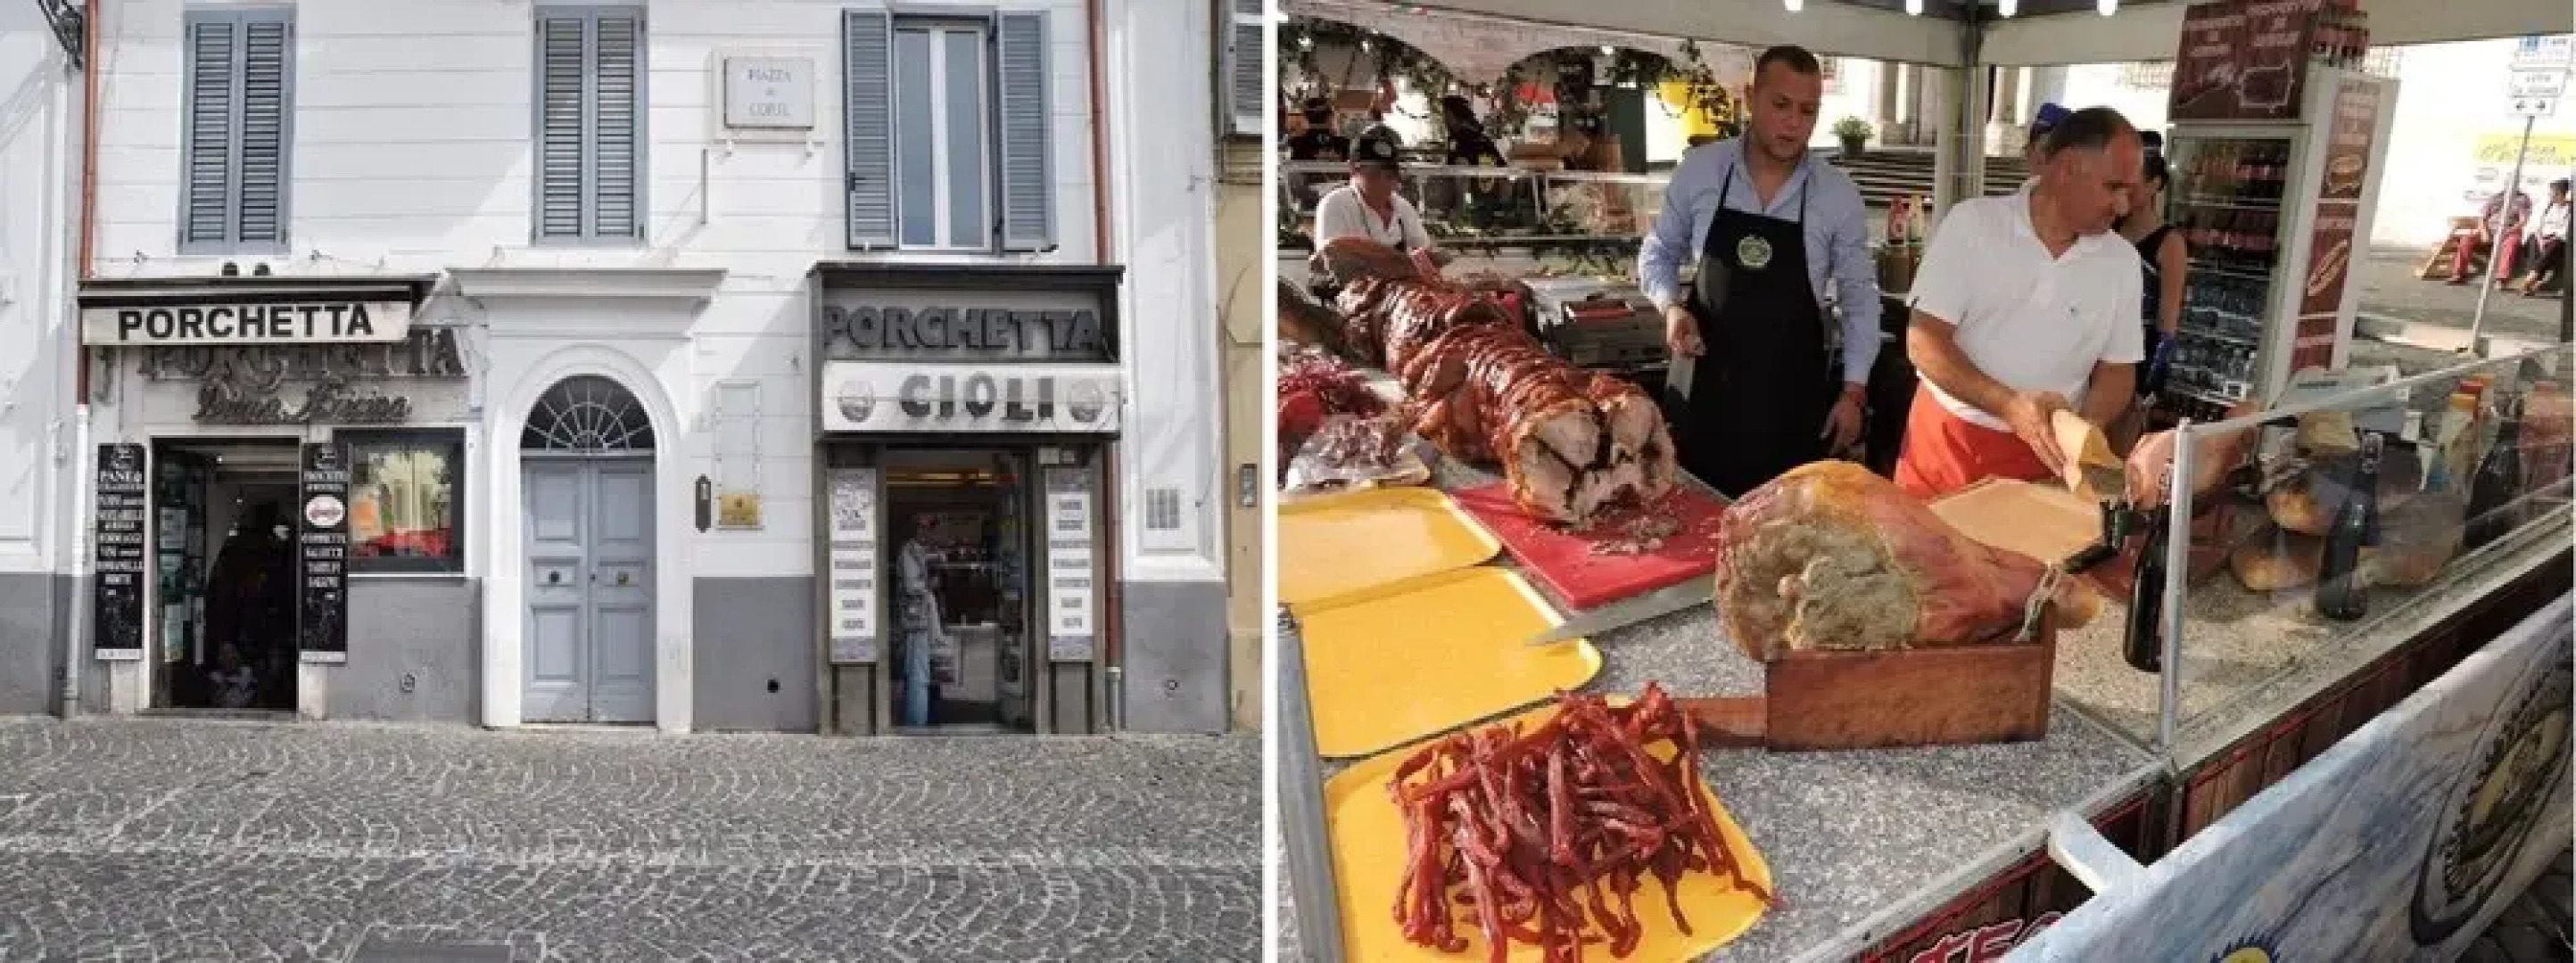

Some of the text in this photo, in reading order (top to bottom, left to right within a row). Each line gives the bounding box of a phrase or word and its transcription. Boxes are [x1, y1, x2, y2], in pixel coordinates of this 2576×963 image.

[118, 302, 374, 341] PORCHETTA
[823, 305, 1102, 350] PORCHETTA
[898, 372, 1056, 422] CIOLI
